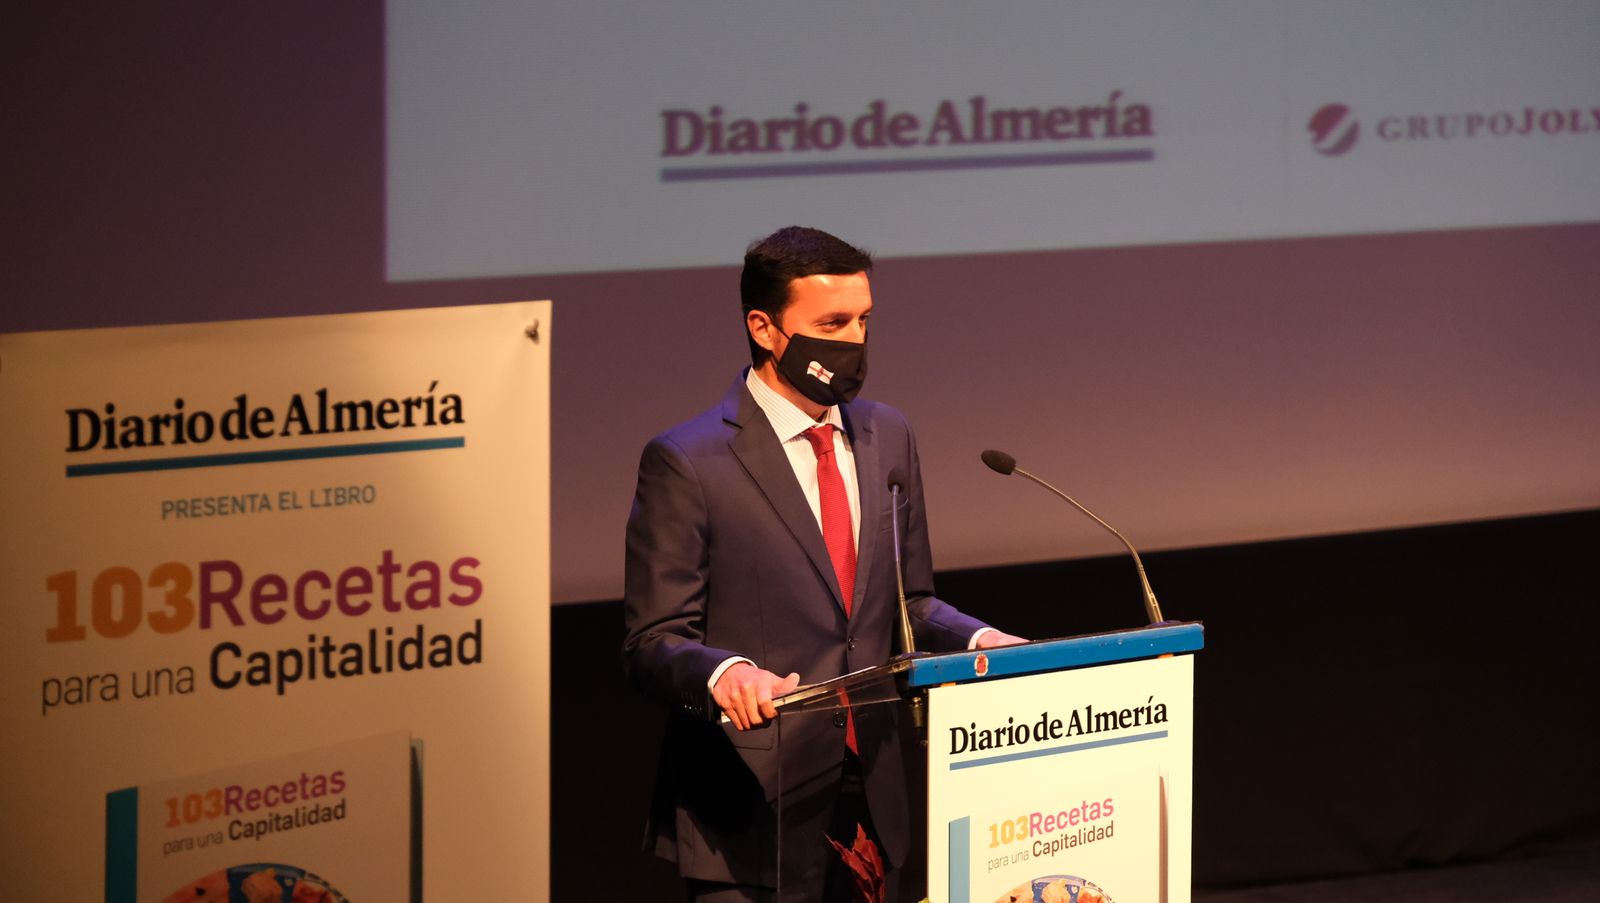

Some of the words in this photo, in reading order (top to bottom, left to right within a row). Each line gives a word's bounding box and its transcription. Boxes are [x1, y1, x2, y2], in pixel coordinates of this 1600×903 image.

[660, 103, 846, 157] Diario
[851, 99, 919, 149] de
[925, 90, 1155, 146] Almería
[65, 398, 214, 452] Diario
[220, 393, 275, 441] de
[279, 381, 465, 436] Almería
[161, 493, 272, 520] PRESENTA
[278, 491, 303, 511] EL
[310, 485, 377, 508] LIBRO
[41, 672, 119, 716] para
[131, 665, 195, 698] una
[209, 618, 483, 695] Capitalidad
[949, 716, 1030, 755] Diario
[1033, 711, 1063, 741] de
[1065, 695, 1168, 737] Almería
[162, 836, 194, 858] para
[196, 831, 224, 848] una
[228, 798, 346, 841] Capitalidad
[987, 855, 1009, 873] para
[1010, 849, 1030, 865] una
[1032, 820, 1115, 858] Capitalidad
